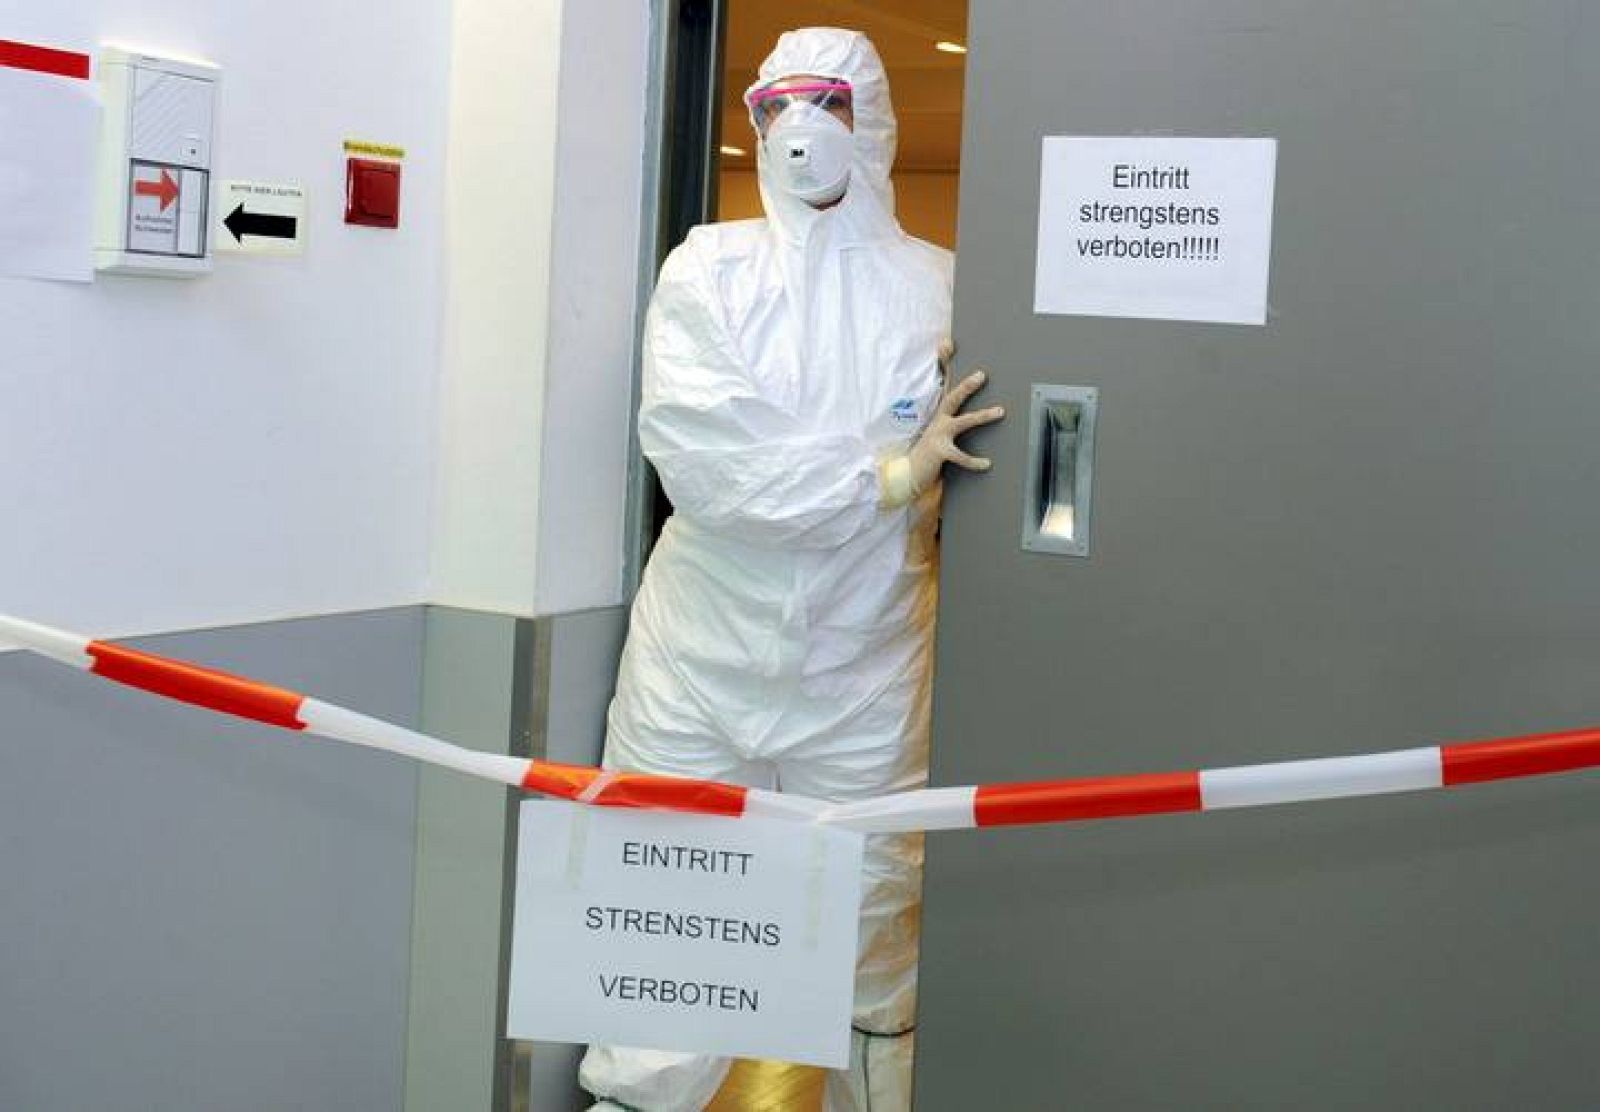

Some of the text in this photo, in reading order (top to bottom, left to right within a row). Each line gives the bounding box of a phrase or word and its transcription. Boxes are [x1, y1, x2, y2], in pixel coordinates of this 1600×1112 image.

[1112, 164, 1190, 190] Eintritt
[1079, 201, 1220, 230] strengstens
[1077, 234, 1219, 261] verboten!!!!!
[622, 842, 753, 876] EINTRITT
[585, 906, 781, 946] STRENSTENS
[600, 974, 759, 1013] VERBOTEN
